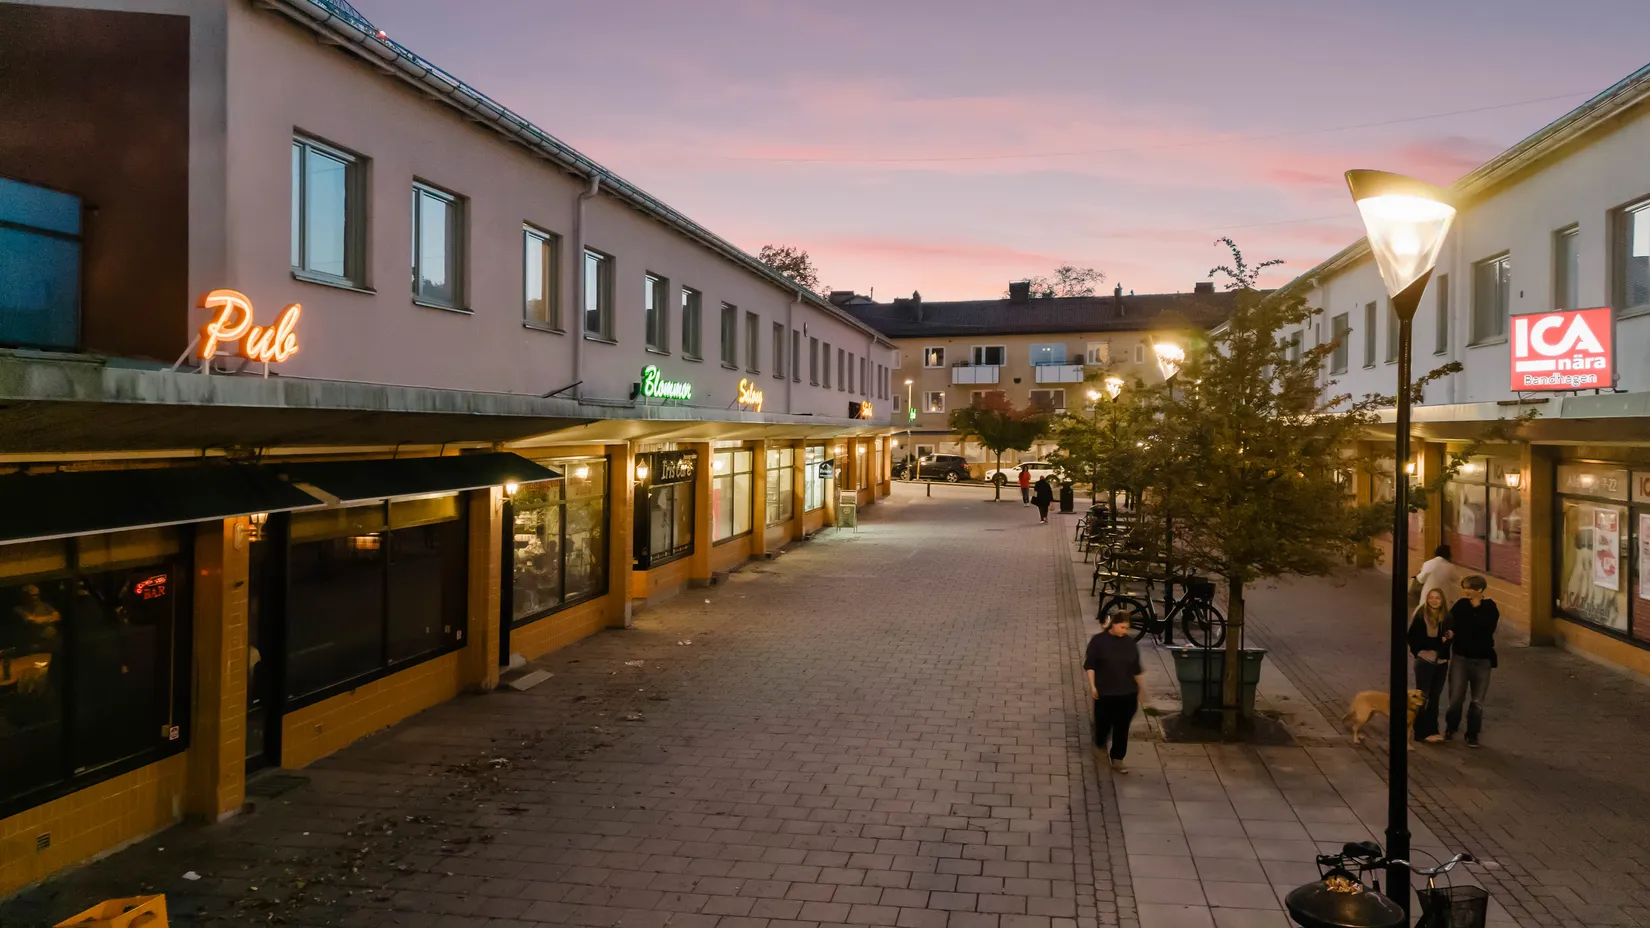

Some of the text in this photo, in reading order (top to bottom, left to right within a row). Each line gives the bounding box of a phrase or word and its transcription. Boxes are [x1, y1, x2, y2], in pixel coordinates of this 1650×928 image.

[202, 288, 301, 362] Pub
[1515, 313, 1605, 357] ICA
[1557, 354, 1606, 371] nära
[644, 364, 692, 400] Blommor
[1524, 372, 1598, 387] Bandhagen
[660, 460, 675, 480] Iris
